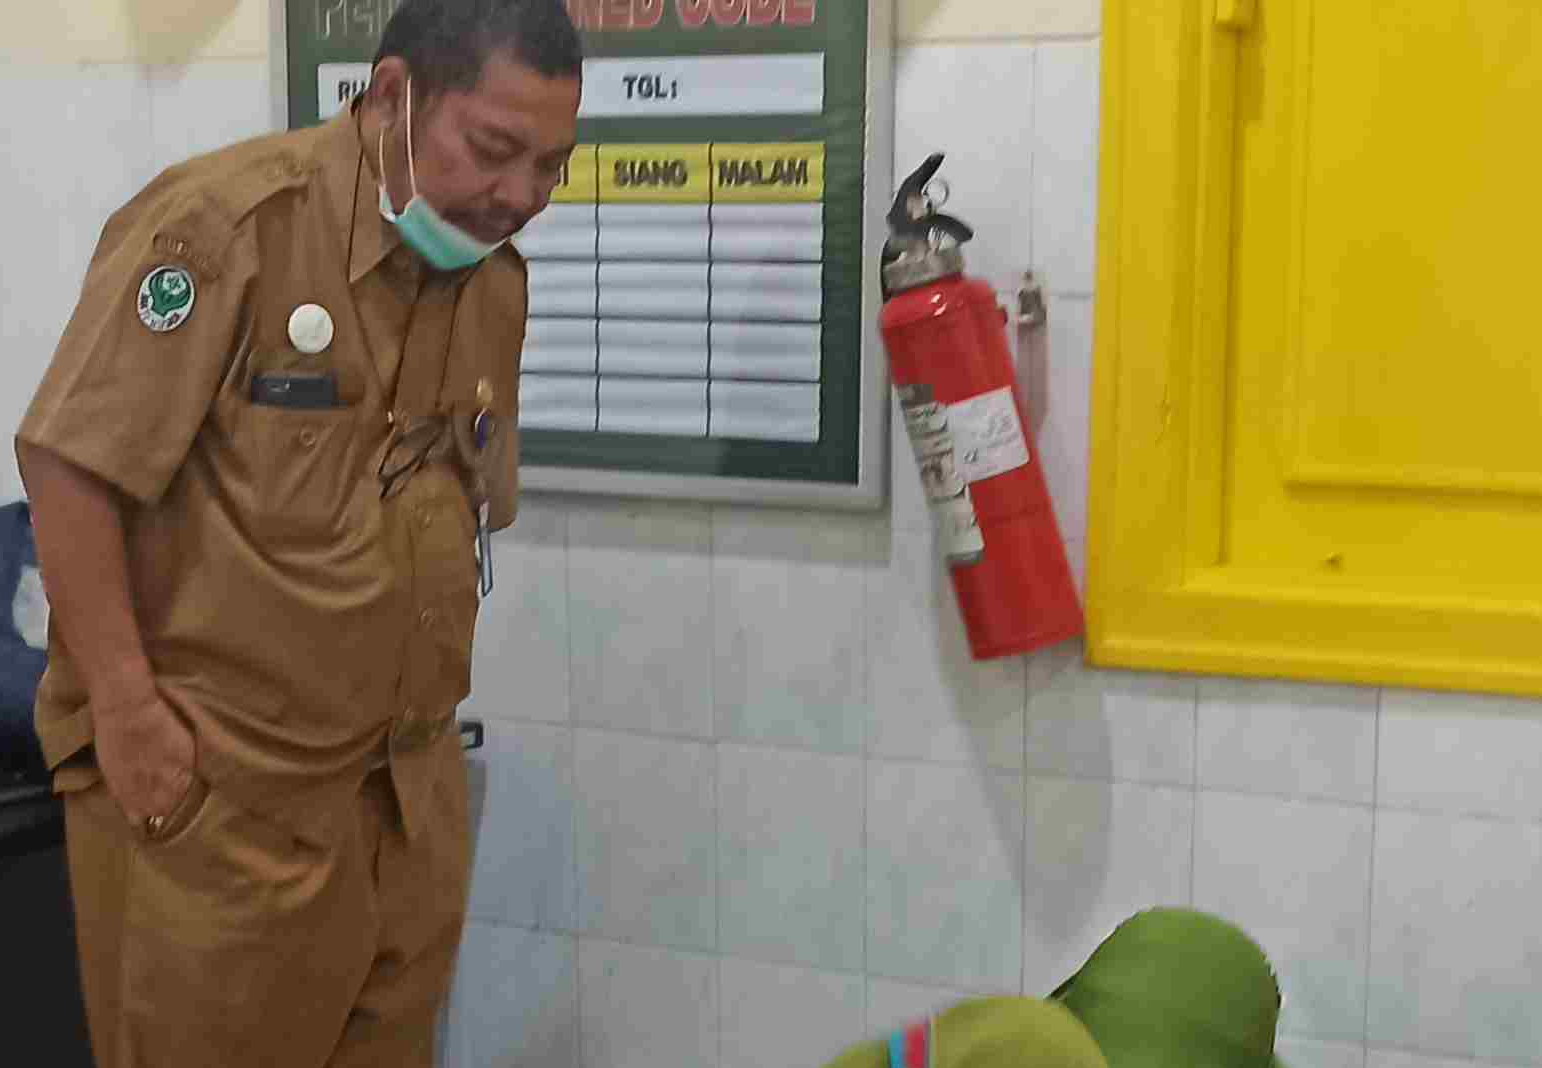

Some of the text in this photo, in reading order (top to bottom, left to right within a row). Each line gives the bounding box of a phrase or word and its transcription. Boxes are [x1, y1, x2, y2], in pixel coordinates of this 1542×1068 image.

[622, 74, 678, 99] TGL:
[613, 159, 689, 187] SIANG
[718, 159, 809, 187] MALAM
